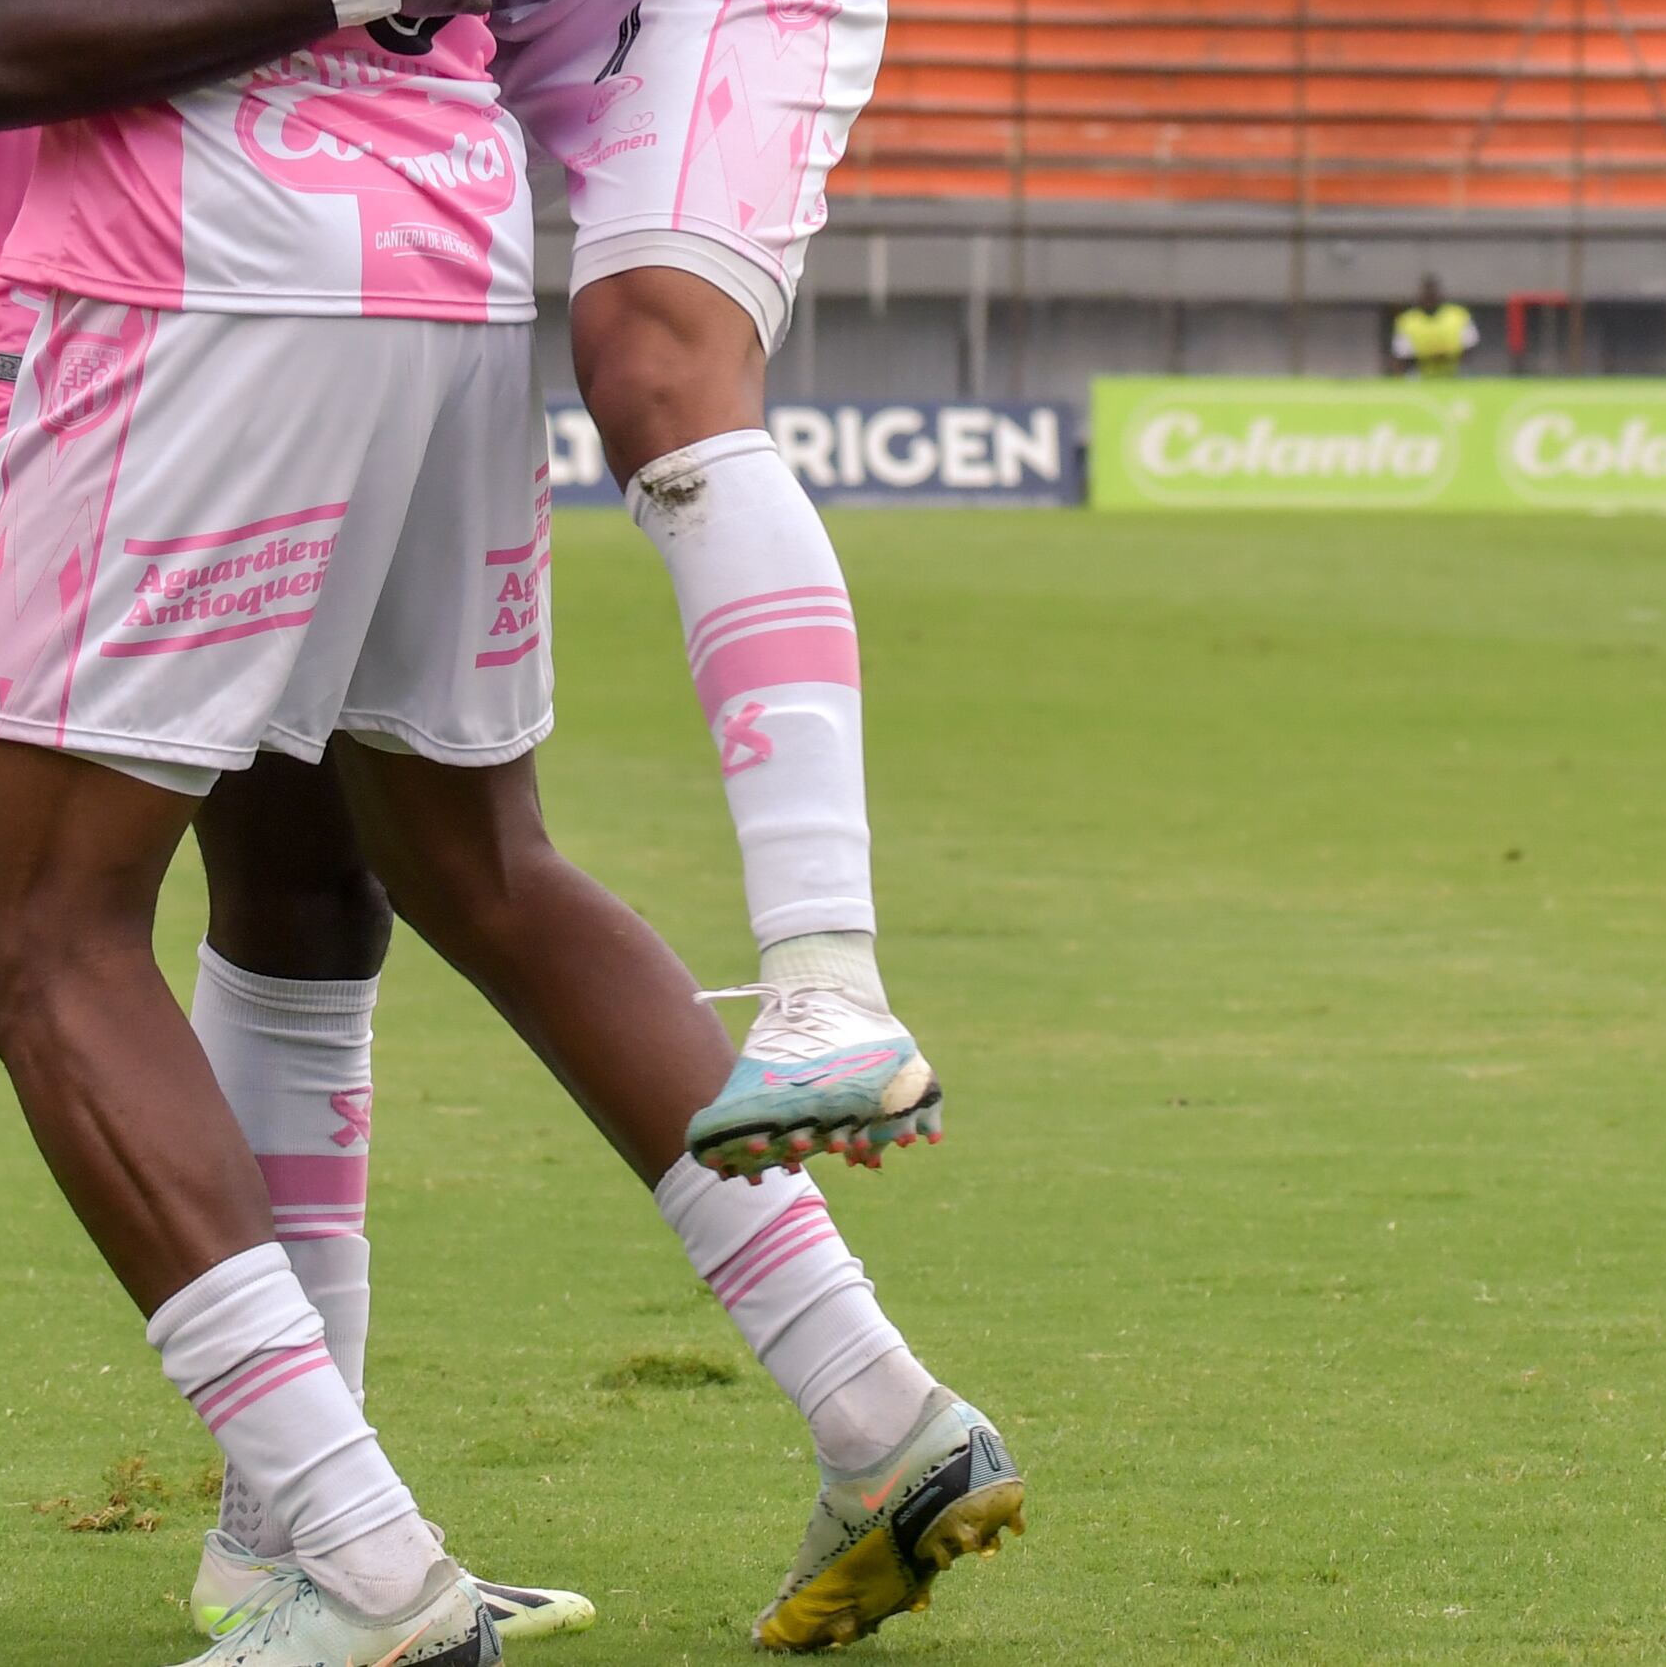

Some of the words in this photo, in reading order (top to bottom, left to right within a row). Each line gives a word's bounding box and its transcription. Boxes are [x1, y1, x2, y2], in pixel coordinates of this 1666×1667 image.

[375, 230, 425, 250] CANTERA
[428, 231, 441, 249] DE
[771, 406, 1061, 487] RIGEN
[1139, 411, 1441, 477] Colanta
